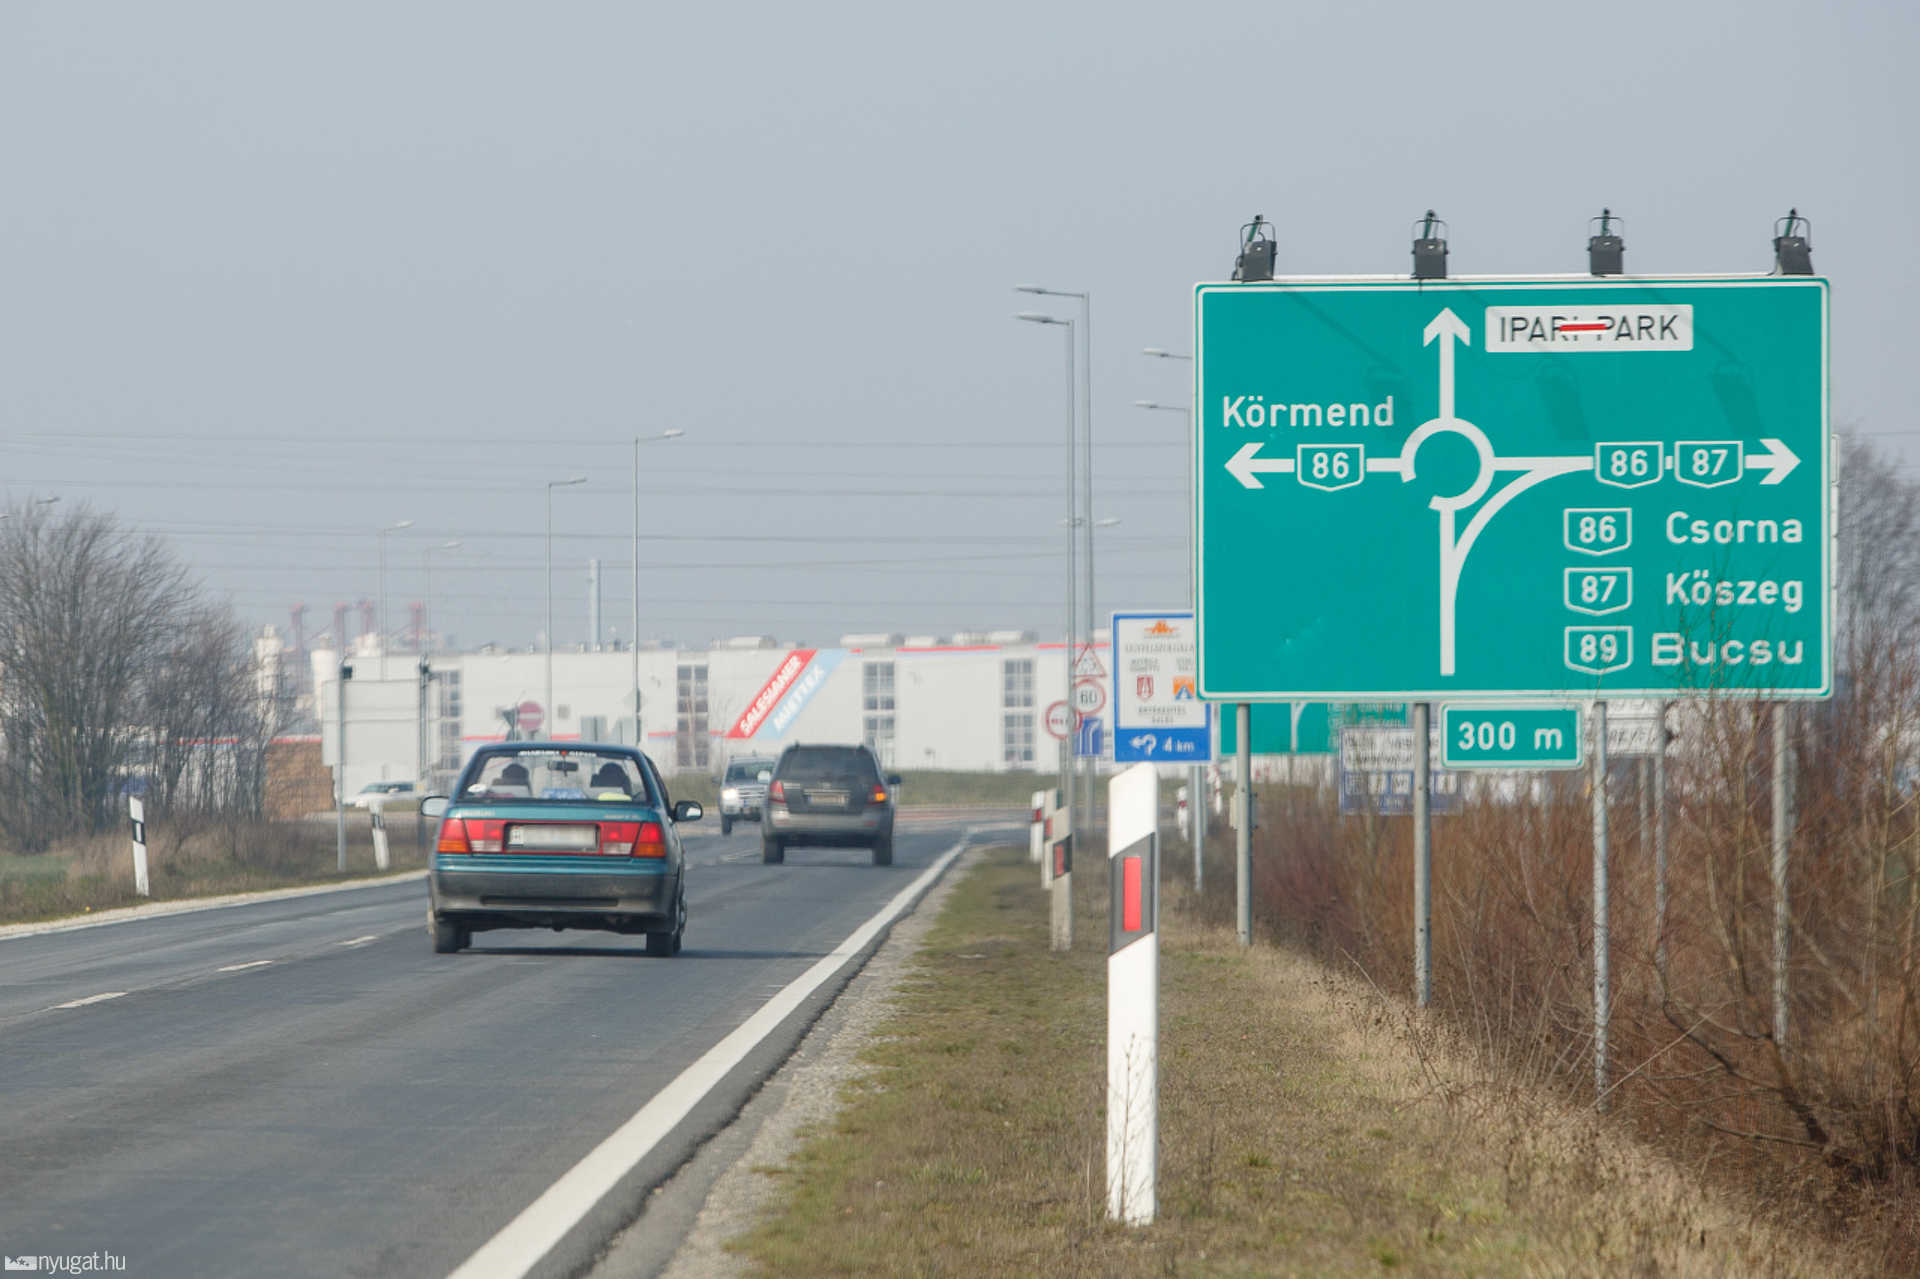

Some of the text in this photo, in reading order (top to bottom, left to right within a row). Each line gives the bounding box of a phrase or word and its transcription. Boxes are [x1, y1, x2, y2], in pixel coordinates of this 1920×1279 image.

[1596, 314, 1679, 341] PARK
[1222, 395, 1395, 428] Körmend
[1311, 452, 1350, 480] 86
[1609, 448, 1728, 477] 86 87
[1578, 511, 1804, 545] 86 Csorna
[1578, 569, 1804, 613] 87 Kőszeg
[1579, 632, 1804, 666] 89 Bucsu
[739, 655, 802, 736] SALESIANER
[1162, 735, 1195, 753] 4 km
[1457, 720, 1516, 751] 300
[1533, 728, 1563, 750] m
